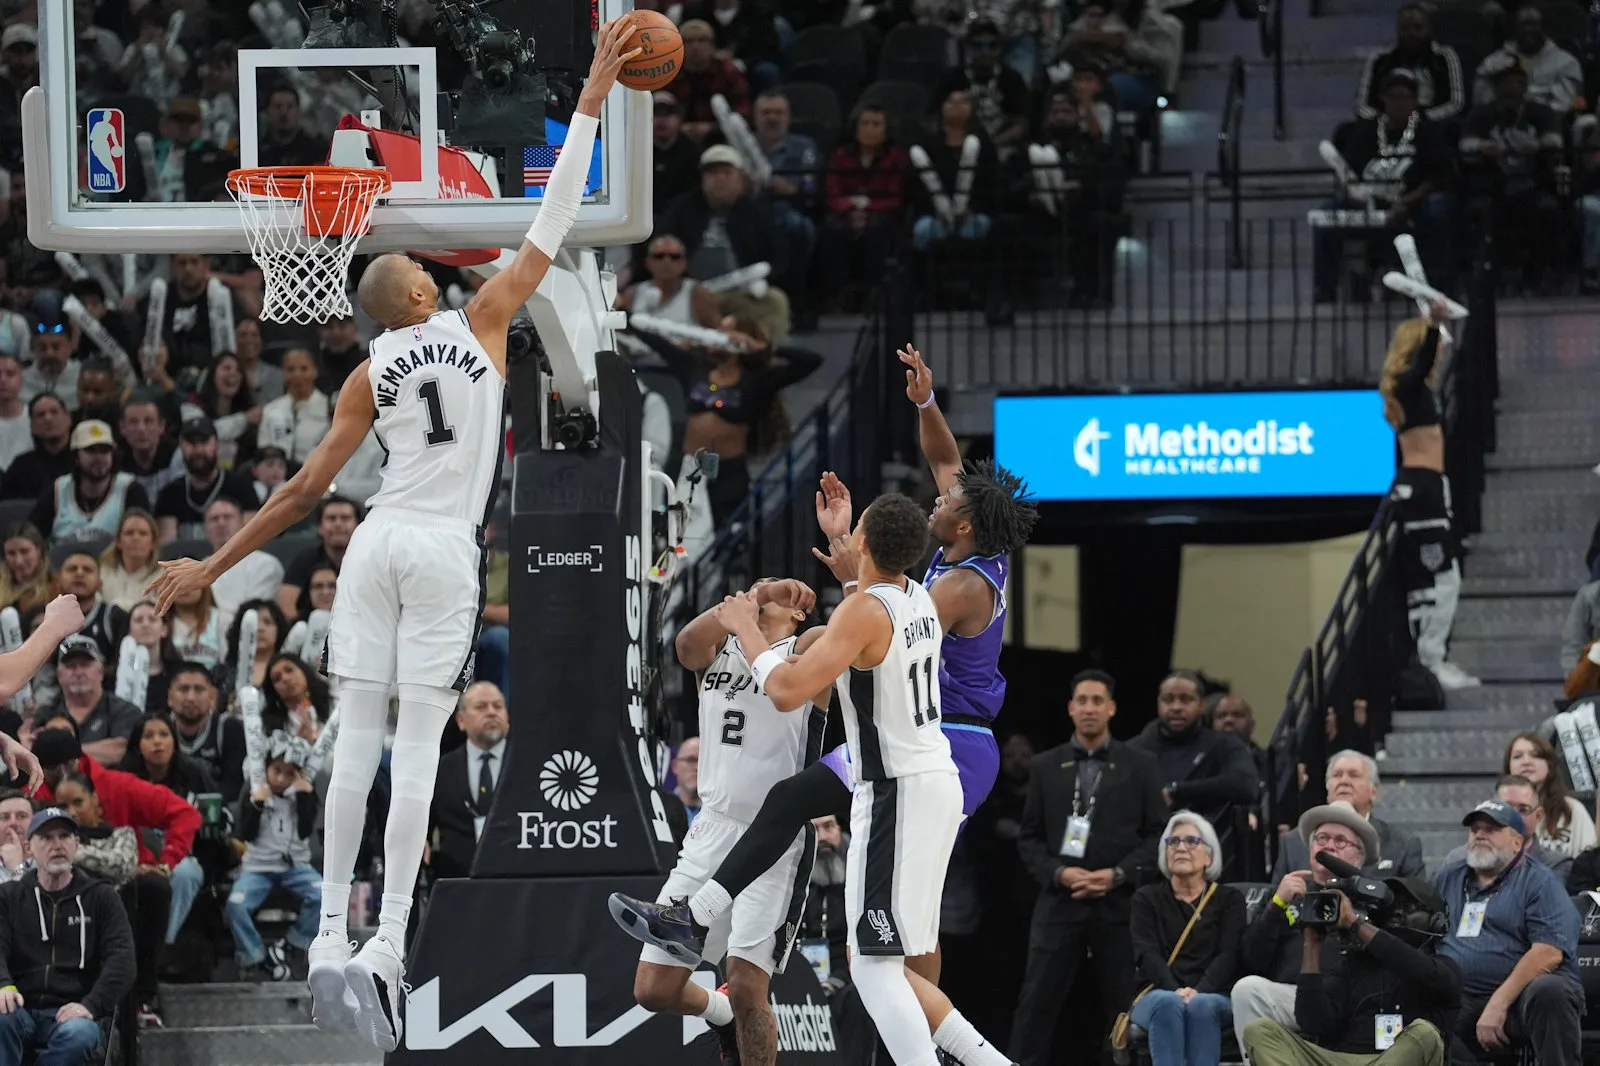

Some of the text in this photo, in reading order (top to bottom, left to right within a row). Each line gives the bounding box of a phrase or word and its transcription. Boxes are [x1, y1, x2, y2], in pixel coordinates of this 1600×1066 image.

[624, 59, 675, 79] Wilson
[93, 173, 112, 187] NBA
[377, 343, 488, 408] WEMBANYAMA
[416, 377, 458, 449] 1
[1124, 419, 1315, 457] Methodist
[1124, 457, 1261, 475] HEALTHCARE
[538, 552, 592, 566] LEDGER
[904, 617, 936, 650] BRYANT
[625, 534, 674, 844] bet365
[907, 655, 940, 728] 11
[720, 708, 748, 747] 2
[516, 811, 618, 849] Frost
[768, 992, 836, 1052] tmaster
